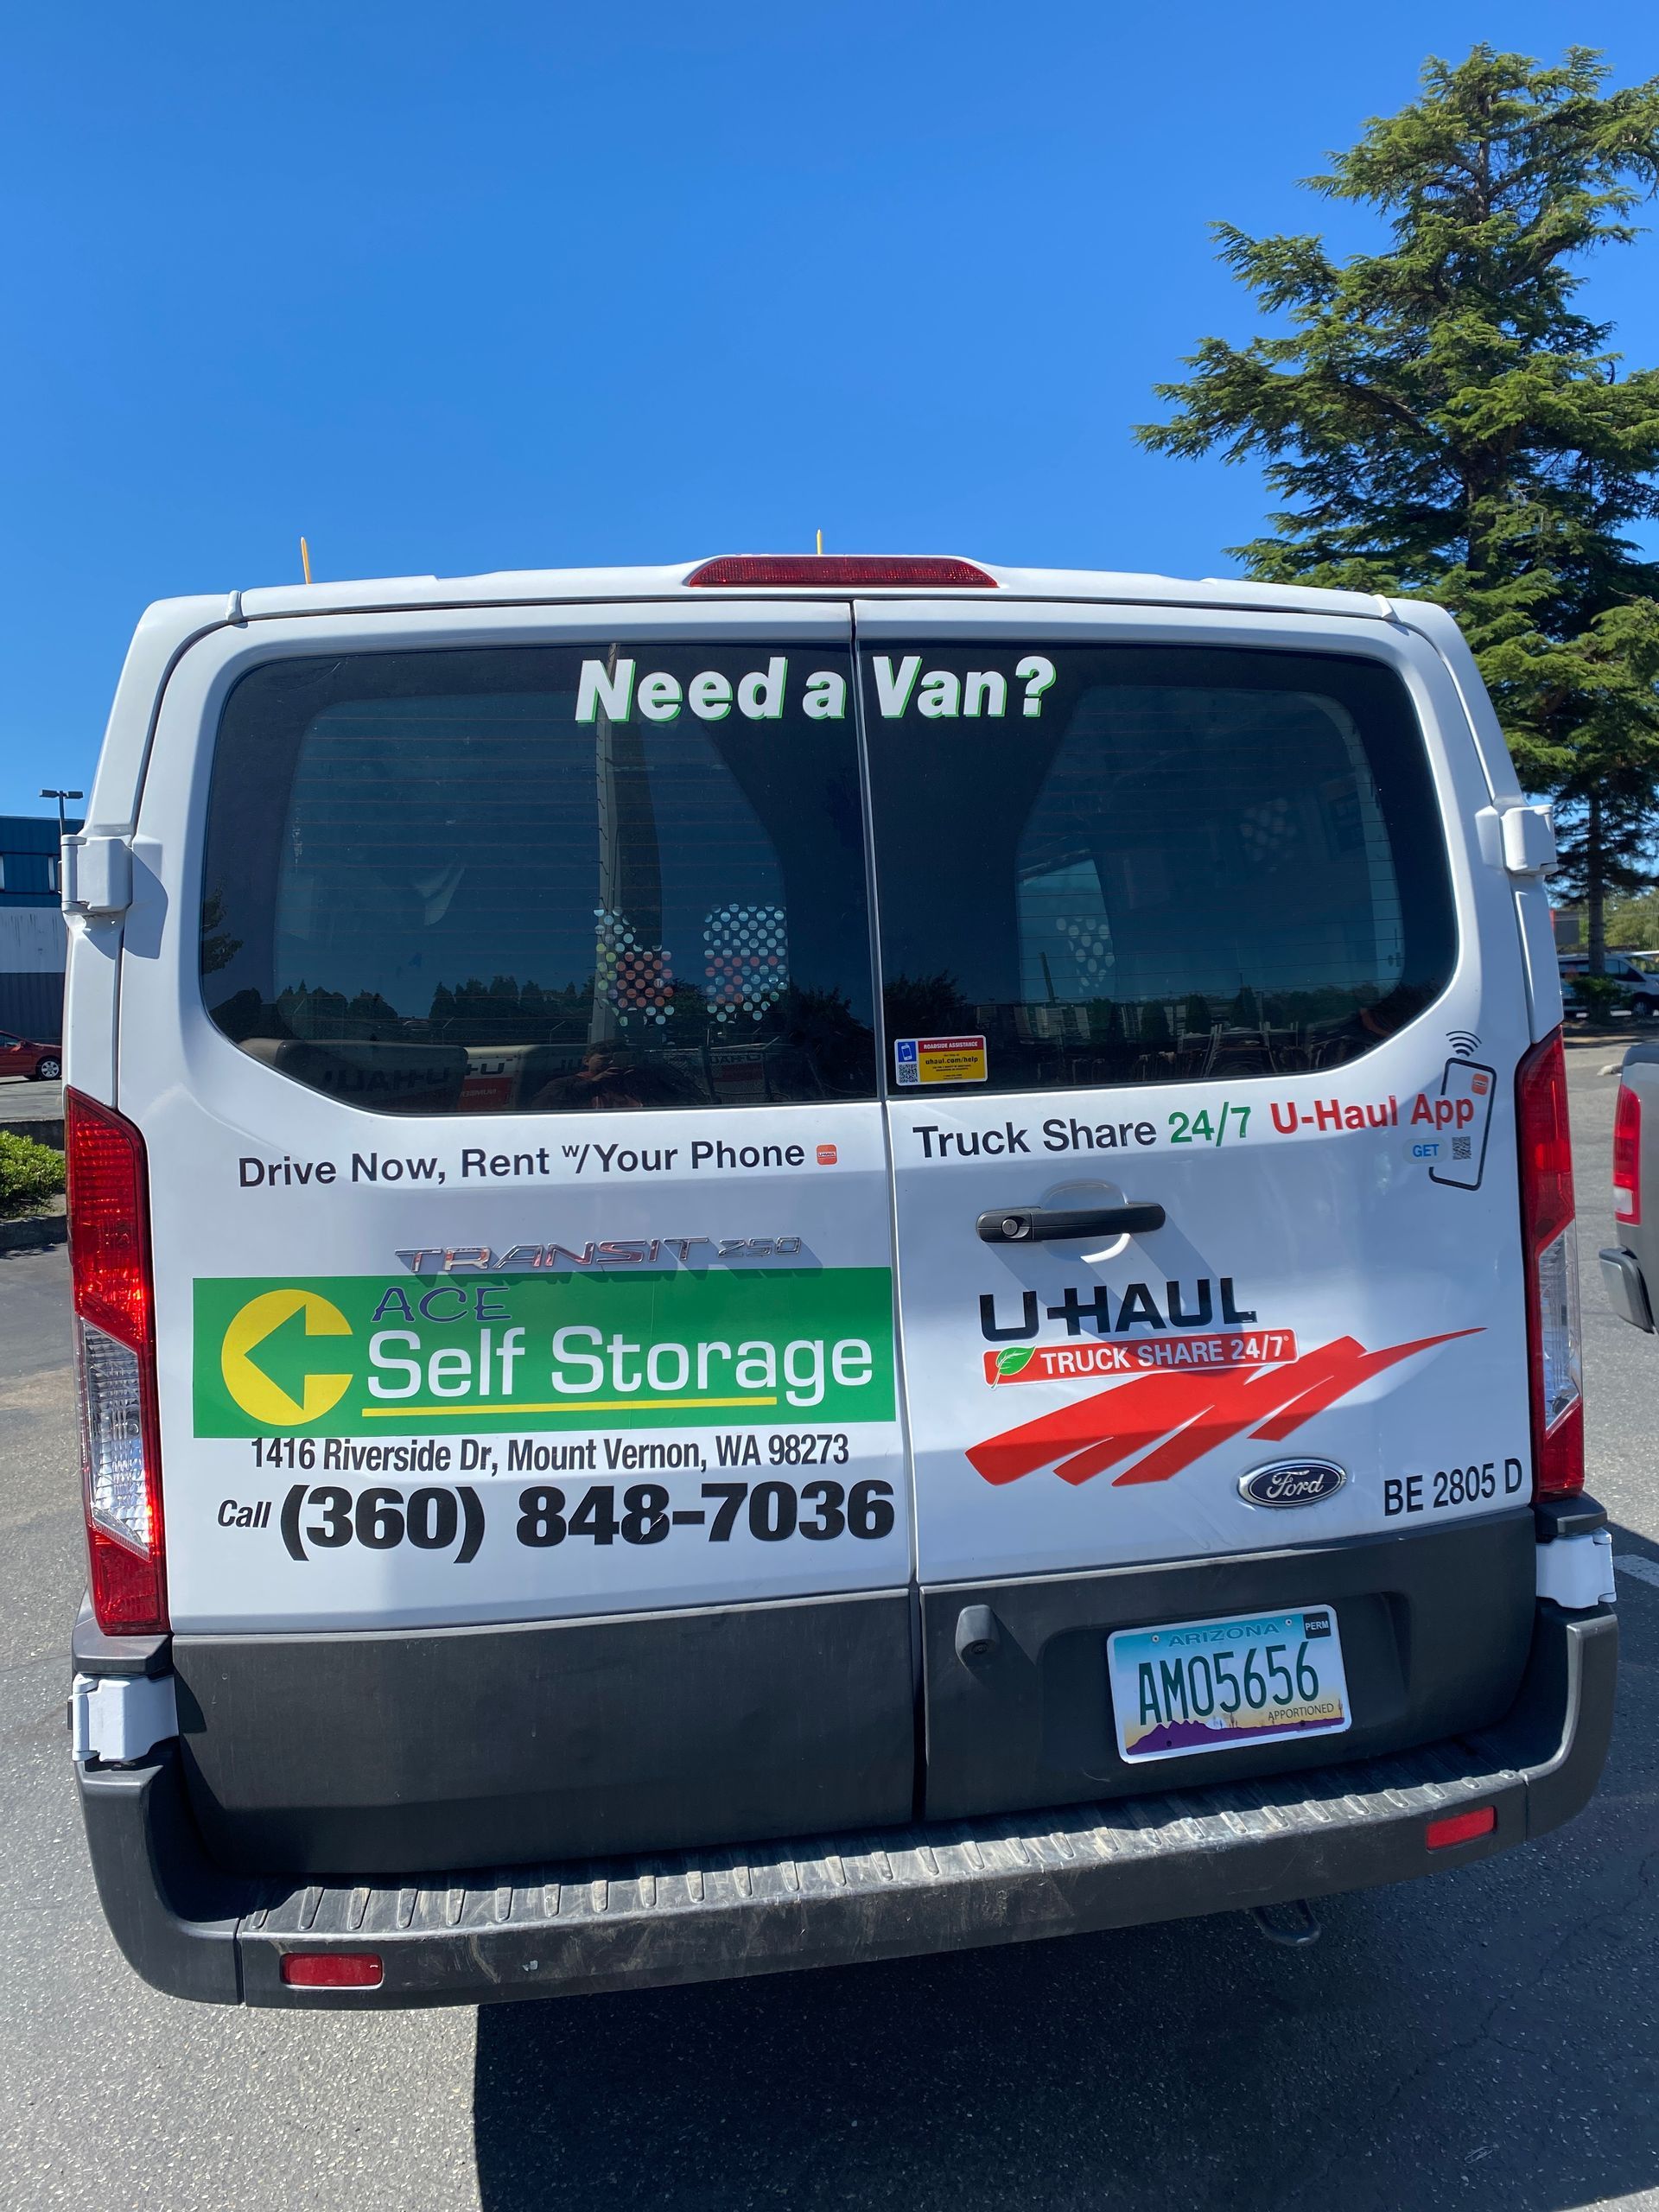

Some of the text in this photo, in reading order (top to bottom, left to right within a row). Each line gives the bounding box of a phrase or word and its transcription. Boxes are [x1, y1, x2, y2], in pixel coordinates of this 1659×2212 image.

[575, 655, 1056, 723] Need a Van?
[925, 1056, 978, 1065] uhaul.com/help
[913, 1093, 1474, 1159] Truck Share 24/7 U-Haul App
[239, 1156, 336, 1188] Drive
[351, 1152, 447, 1185] Now,
[461, 1147, 550, 1179] Rent
[691, 1140, 806, 1171] Phone
[1412, 1143, 1440, 1158] GET
[395, 1236, 802, 1273] TRANSIT 250
[371, 1286, 512, 1324] ACE
[979, 1277, 1257, 1342] U-HAUL
[368, 1324, 874, 1407] Self Storage
[1039, 1347, 1131, 1374] TRUCK
[1137, 1340, 1224, 1367] SHARE
[251, 1434, 849, 1477] 1416 Riverside Dr, Mount Vernon, WA 98273
[1265, 1471, 1325, 1497] Ford
[1384, 1457, 1522, 1517] BE 2805 D
[218, 1479, 896, 1564] Call (360) 848-7036
[1168, 1620, 1330, 1647] ARIZONA PERM
[1138, 1642, 1319, 1726] AM05656
[1268, 1702, 1335, 1722] APPORTIONED
